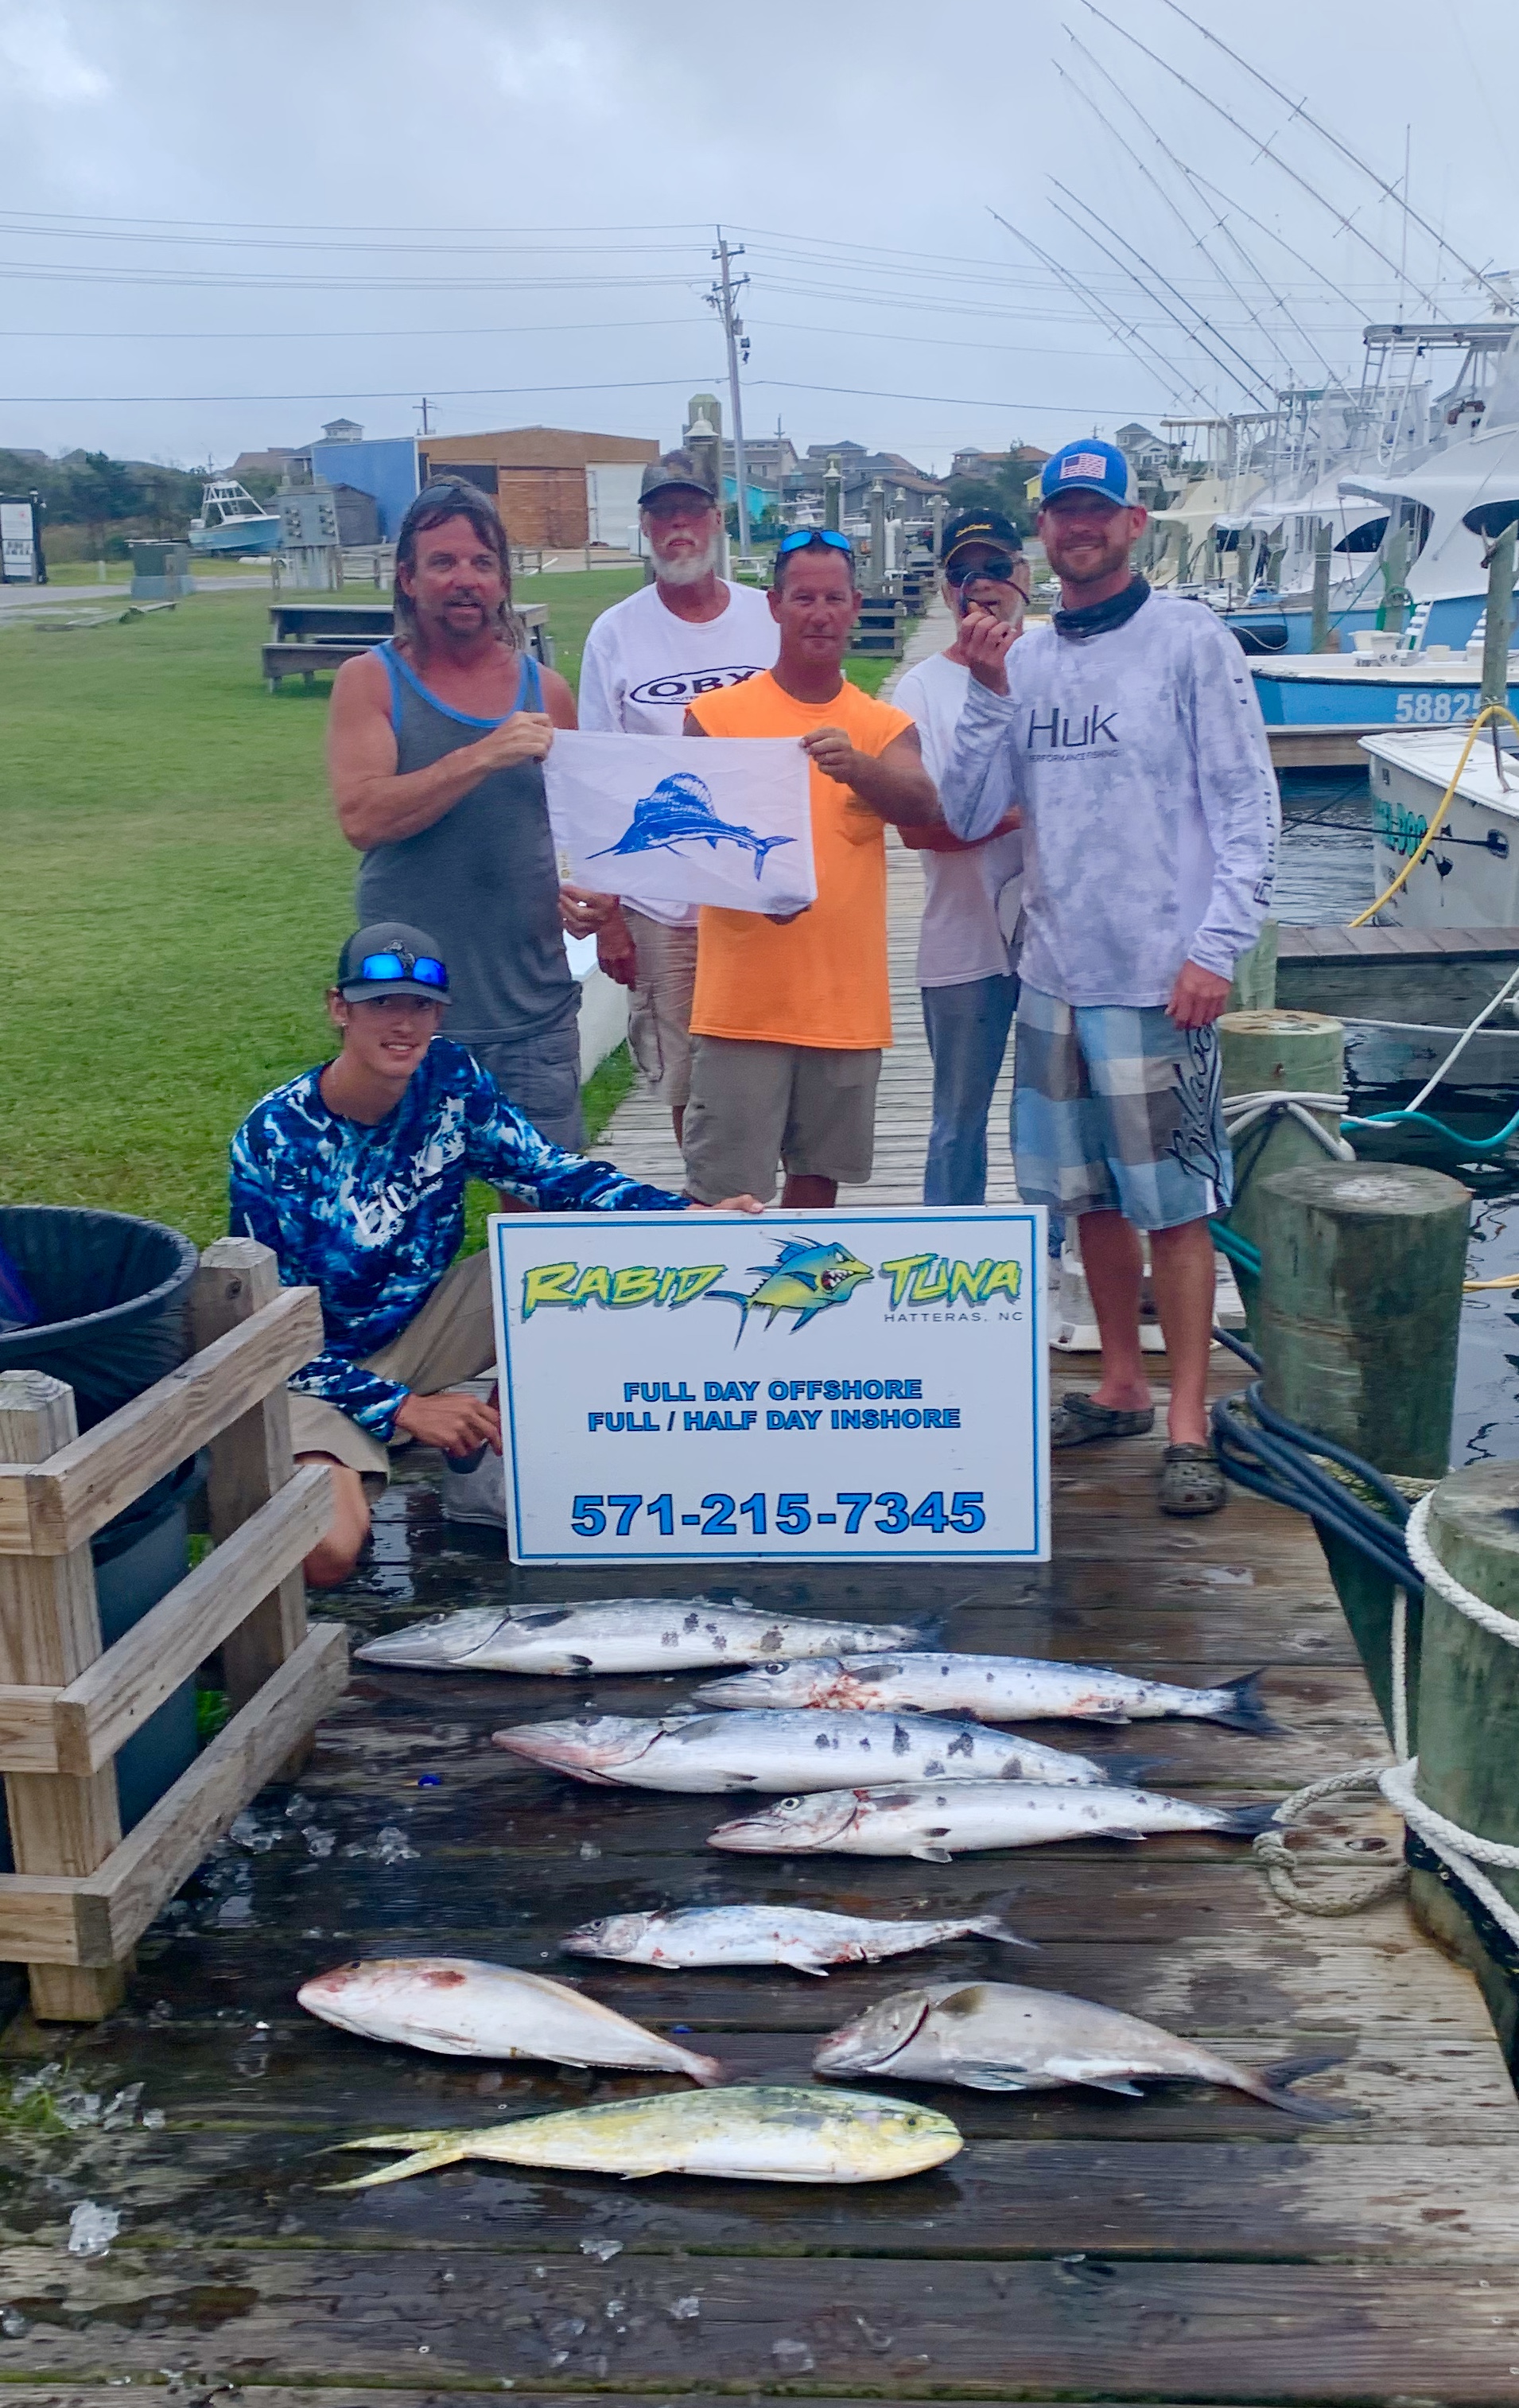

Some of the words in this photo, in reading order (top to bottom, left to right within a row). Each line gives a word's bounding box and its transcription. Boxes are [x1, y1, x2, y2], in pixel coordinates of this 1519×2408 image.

[648, 671, 756, 697] OBX
[521, 1262, 728, 1323] RABID
[879, 1253, 1022, 1309] TUNA
[998, 1312, 1024, 1321] NC
[624, 1382, 696, 1402] FULL
[704, 1381, 760, 1402] DAY
[768, 1379, 923, 1401] OFFSHORE
[588, 1411, 660, 1432] FULL
[683, 1410, 758, 1431] HALF
[766, 1409, 823, 1430] DAY
[831, 1408, 961, 1430] INSHORE
[570, 1491, 985, 1536] 571-215-7345
